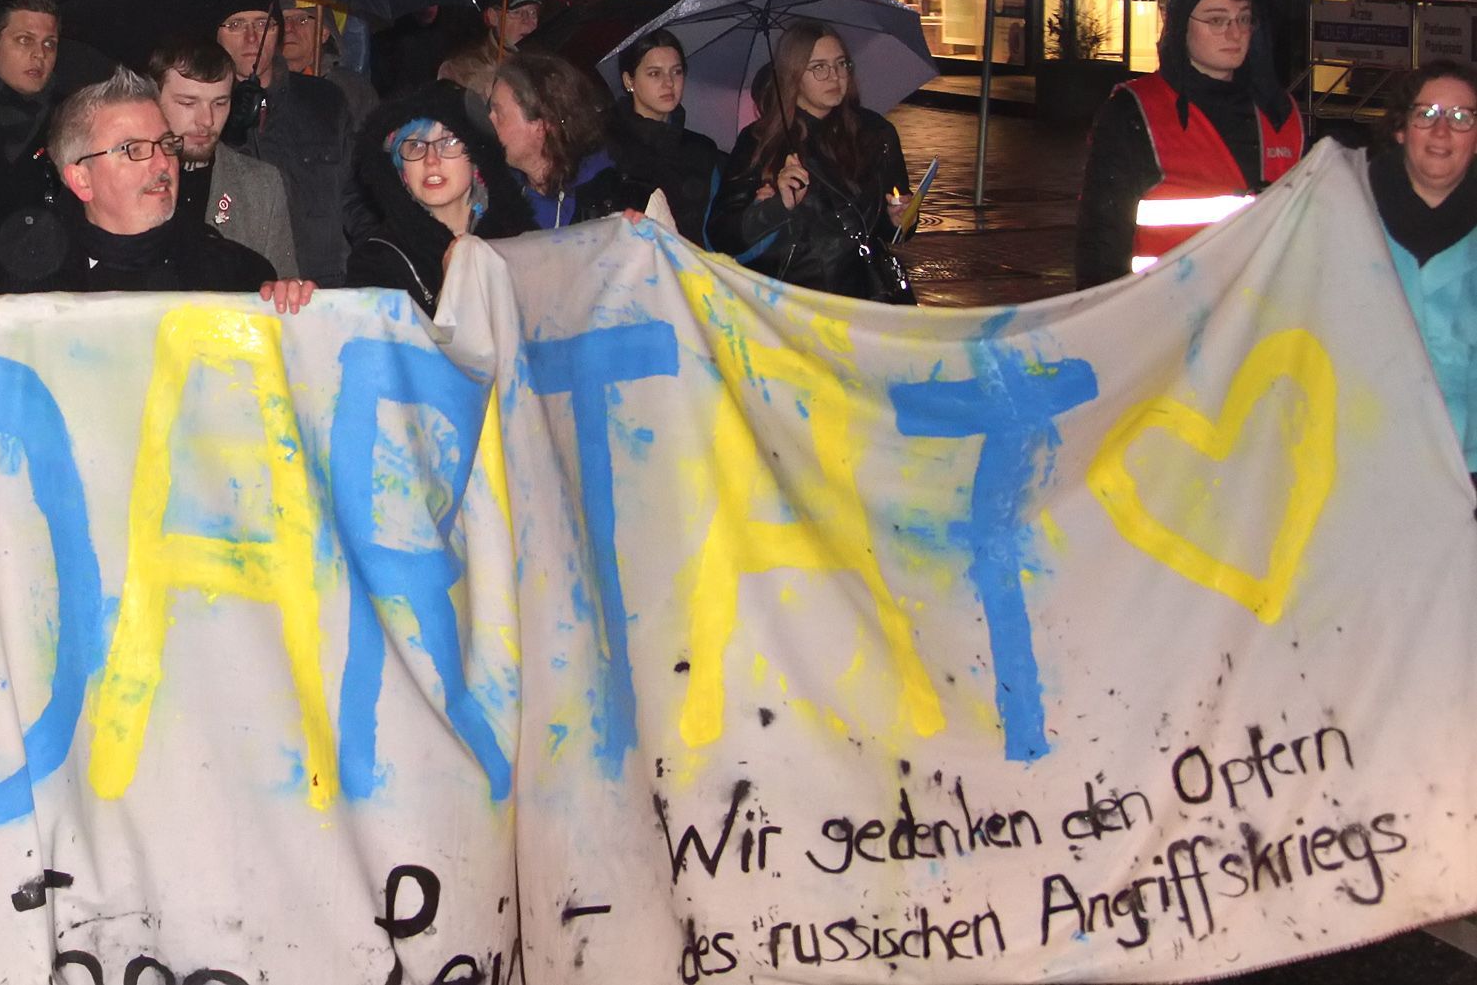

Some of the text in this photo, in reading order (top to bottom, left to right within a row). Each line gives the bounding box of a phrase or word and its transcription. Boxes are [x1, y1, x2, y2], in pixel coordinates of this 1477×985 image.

[653, 725, 1355, 885] Wir gedenken den Opfern
[681, 813, 1408, 985] des russischen Angriffskriegs
